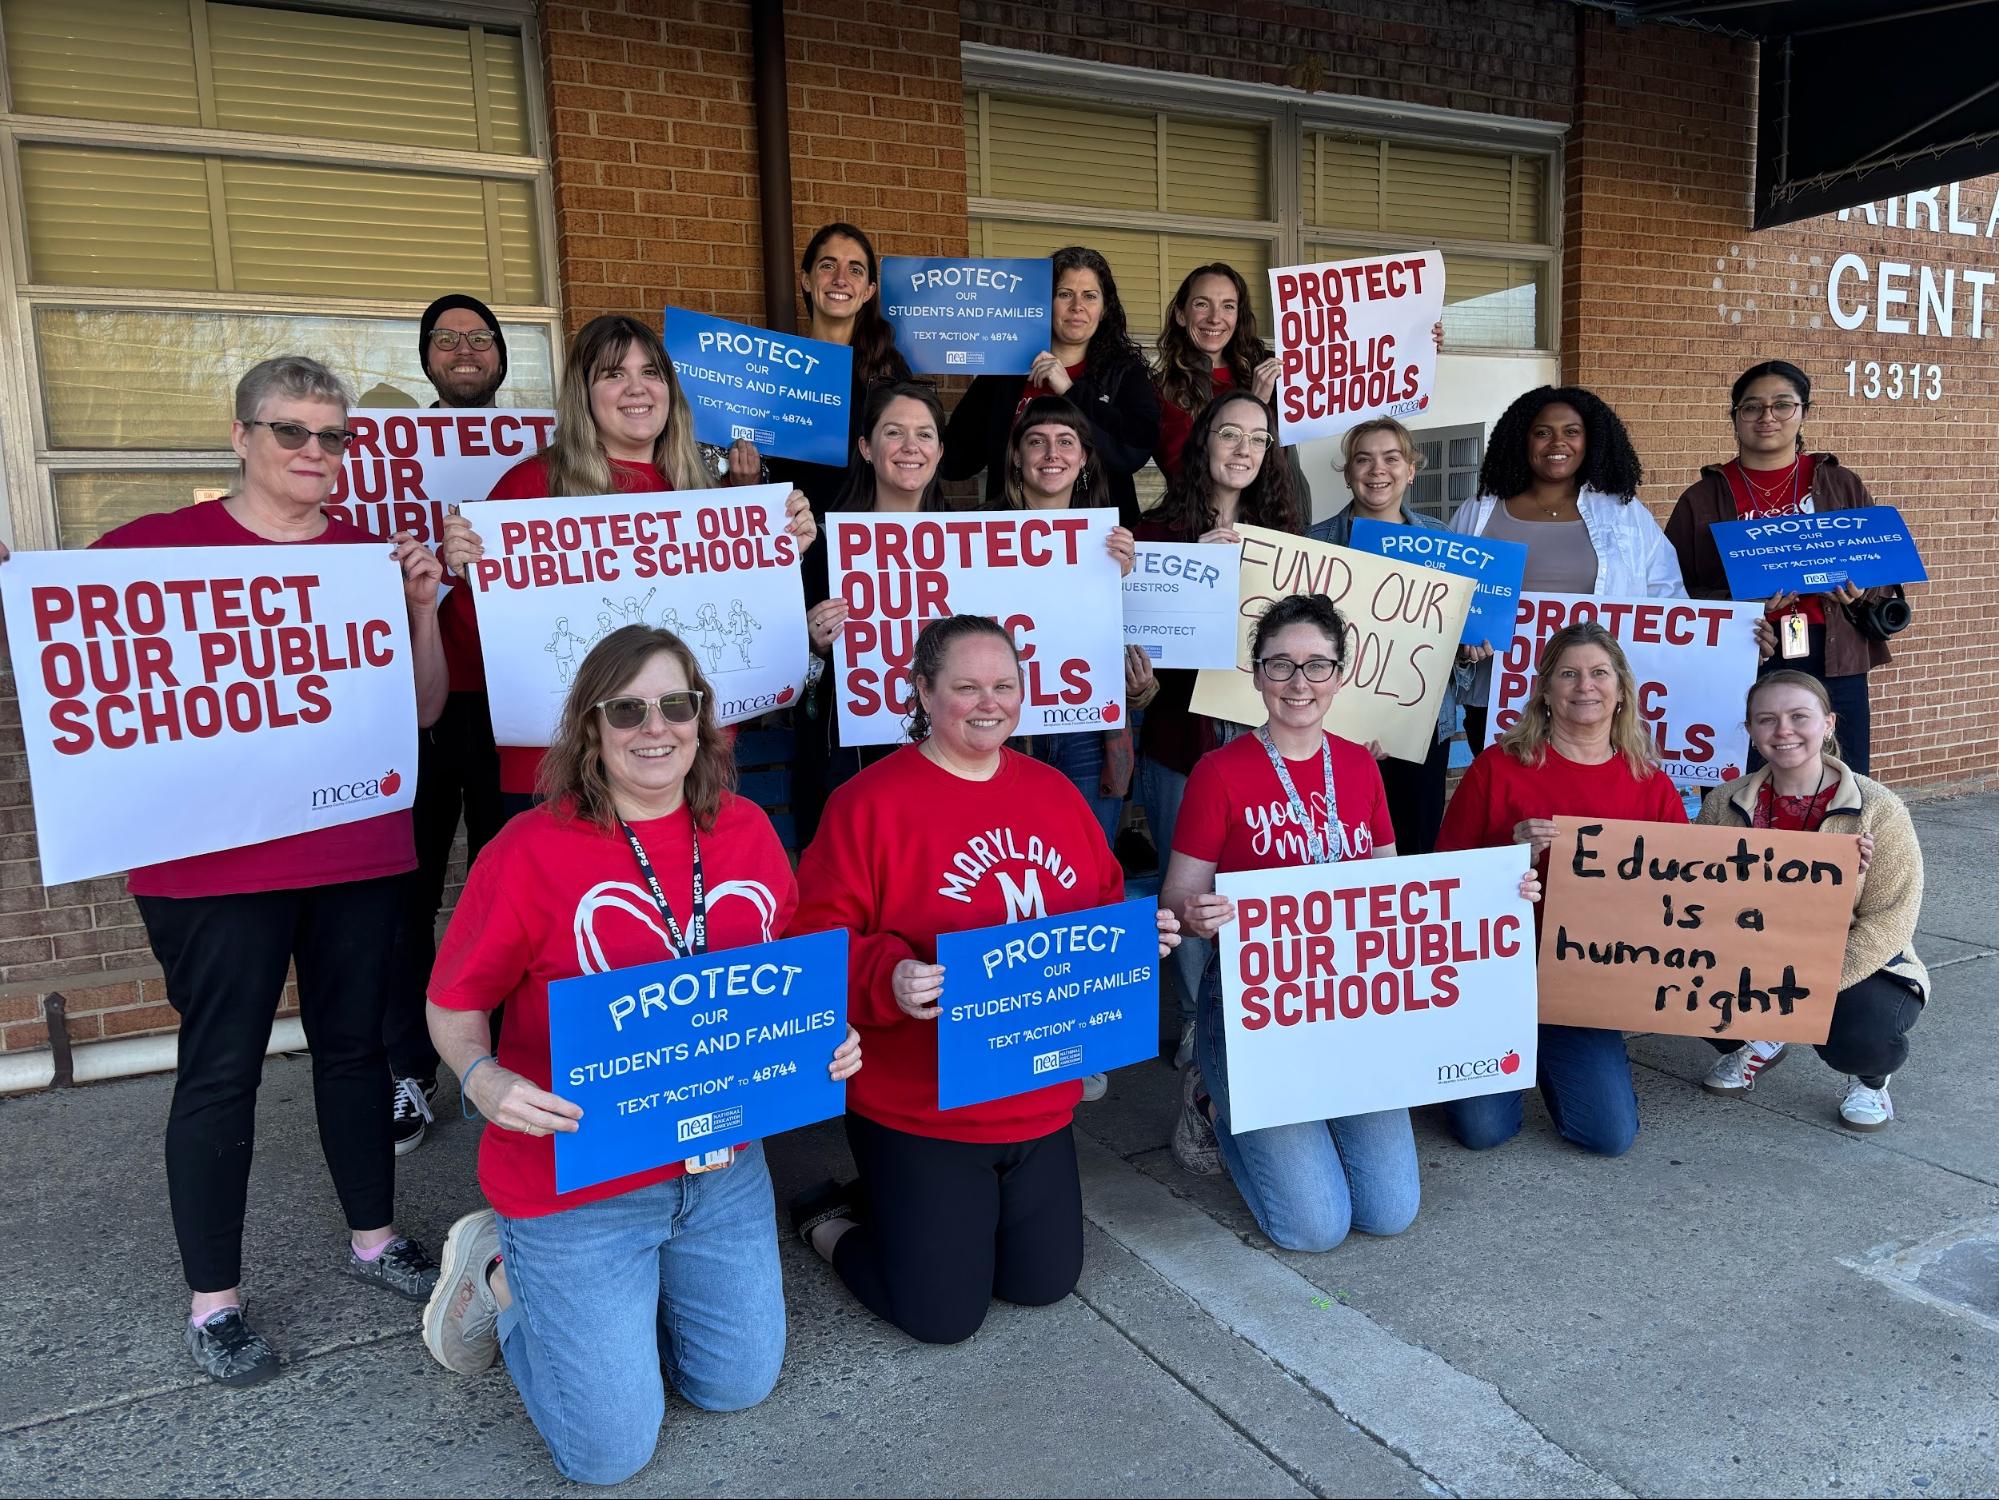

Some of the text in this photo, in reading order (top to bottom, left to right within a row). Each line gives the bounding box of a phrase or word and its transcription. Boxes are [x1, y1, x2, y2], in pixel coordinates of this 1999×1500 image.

[911, 267, 1023, 293] PROTECT
[956, 292, 977, 301] OUR
[1277, 259, 1426, 312] PROTECT
[1828, 254, 1996, 339] CENT
[888, 306, 1044, 318] STUDENTS AND FAMILIES
[1281, 306, 1349, 350] OUR
[698, 332, 819, 375] PROTECT
[913, 331, 937, 341] TEXT
[990, 332, 1018, 341] 48744
[746, 362, 769, 375] OUR
[947, 353, 966, 363] nea
[1282, 335, 1395, 387] PUBLIC
[673, 362, 841, 406] STUDENTS AND FAMILIES
[1283, 365, 1419, 423] SCHOOLS
[1844, 360, 1943, 400] 13313
[698, 395, 723, 410] TEXT
[782, 413, 813, 426] 48744
[1391, 400, 1419, 415] mcea
[344, 416, 556, 458] ROTECT
[733, 427, 753, 440] nea
[501, 505, 770, 555] PROTECT OUR
[838, 518, 1088, 570] PROTECT
[1729, 534, 1902, 558] STUDENTS AND FAMILIES
[1746, 517, 1868, 540] PROTECT
[1799, 532, 1823, 540] OUR
[477, 548, 621, 592] PUBLIC
[632, 535, 795, 578] SCHOOLS
[1381, 535, 1494, 570] PROTECT
[1424, 560, 1447, 571] OUR
[1762, 561, 1789, 571] TEXT
[1849, 553, 1881, 562] 48744
[841, 571, 953, 620] OUR
[1240, 537, 1449, 634] FUND OUR
[1805, 574, 1828, 584] nea
[31, 575, 320, 642] PROTECT
[1513, 600, 1733, 646] PROTECT
[41, 619, 394, 699] OUR PUBLIC
[844, 614, 1036, 668] PUC
[722, 693, 777, 715] mcea
[847, 658, 1093, 717] SCLS
[48, 675, 332, 756] SCHOOLS
[1043, 707, 1101, 723] mcea
[1664, 763, 1719, 778] mcea
[312, 779, 379, 807] mcea
[630, 837, 650, 867] MCPS
[938, 827, 1078, 904] MARYLAND
[1572, 824, 1843, 886] Education
[648, 876, 667, 908] MCPS
[693, 873, 703, 905] MCPS
[994, 869, 1048, 924] M
[695, 914, 705, 947] MCPS
[1237, 878, 1461, 942] PROTECT
[1662, 894, 1765, 932] is a
[667, 917, 685, 949] MCPS
[982, 925, 1126, 979] PROTECT
[1239, 914, 1521, 986] OUR PUBLIC
[1556, 925, 1717, 970] human
[1043, 962, 1071, 978] OUR
[608, 964, 802, 1032] PROTECT
[951, 966, 1151, 1022] STUDENTS AND FAMILIES
[1241, 965, 1460, 1030] SCHOOLS
[1654, 965, 1811, 1034] right
[692, 1008, 728, 1027] OUR
[988, 1032, 1020, 1050] TEXT
[1089, 1009, 1123, 1026] 48744
[569, 1010, 836, 1087] STUDENTS AND FAMILIES
[1035, 1054, 1058, 1072] nea
[1438, 1058, 1499, 1080] mcea
[617, 1093, 660, 1116] TEXT
[738, 1077, 749, 1086] TO
[752, 1061, 797, 1083] 48744
[680, 1117, 710, 1138] nea
